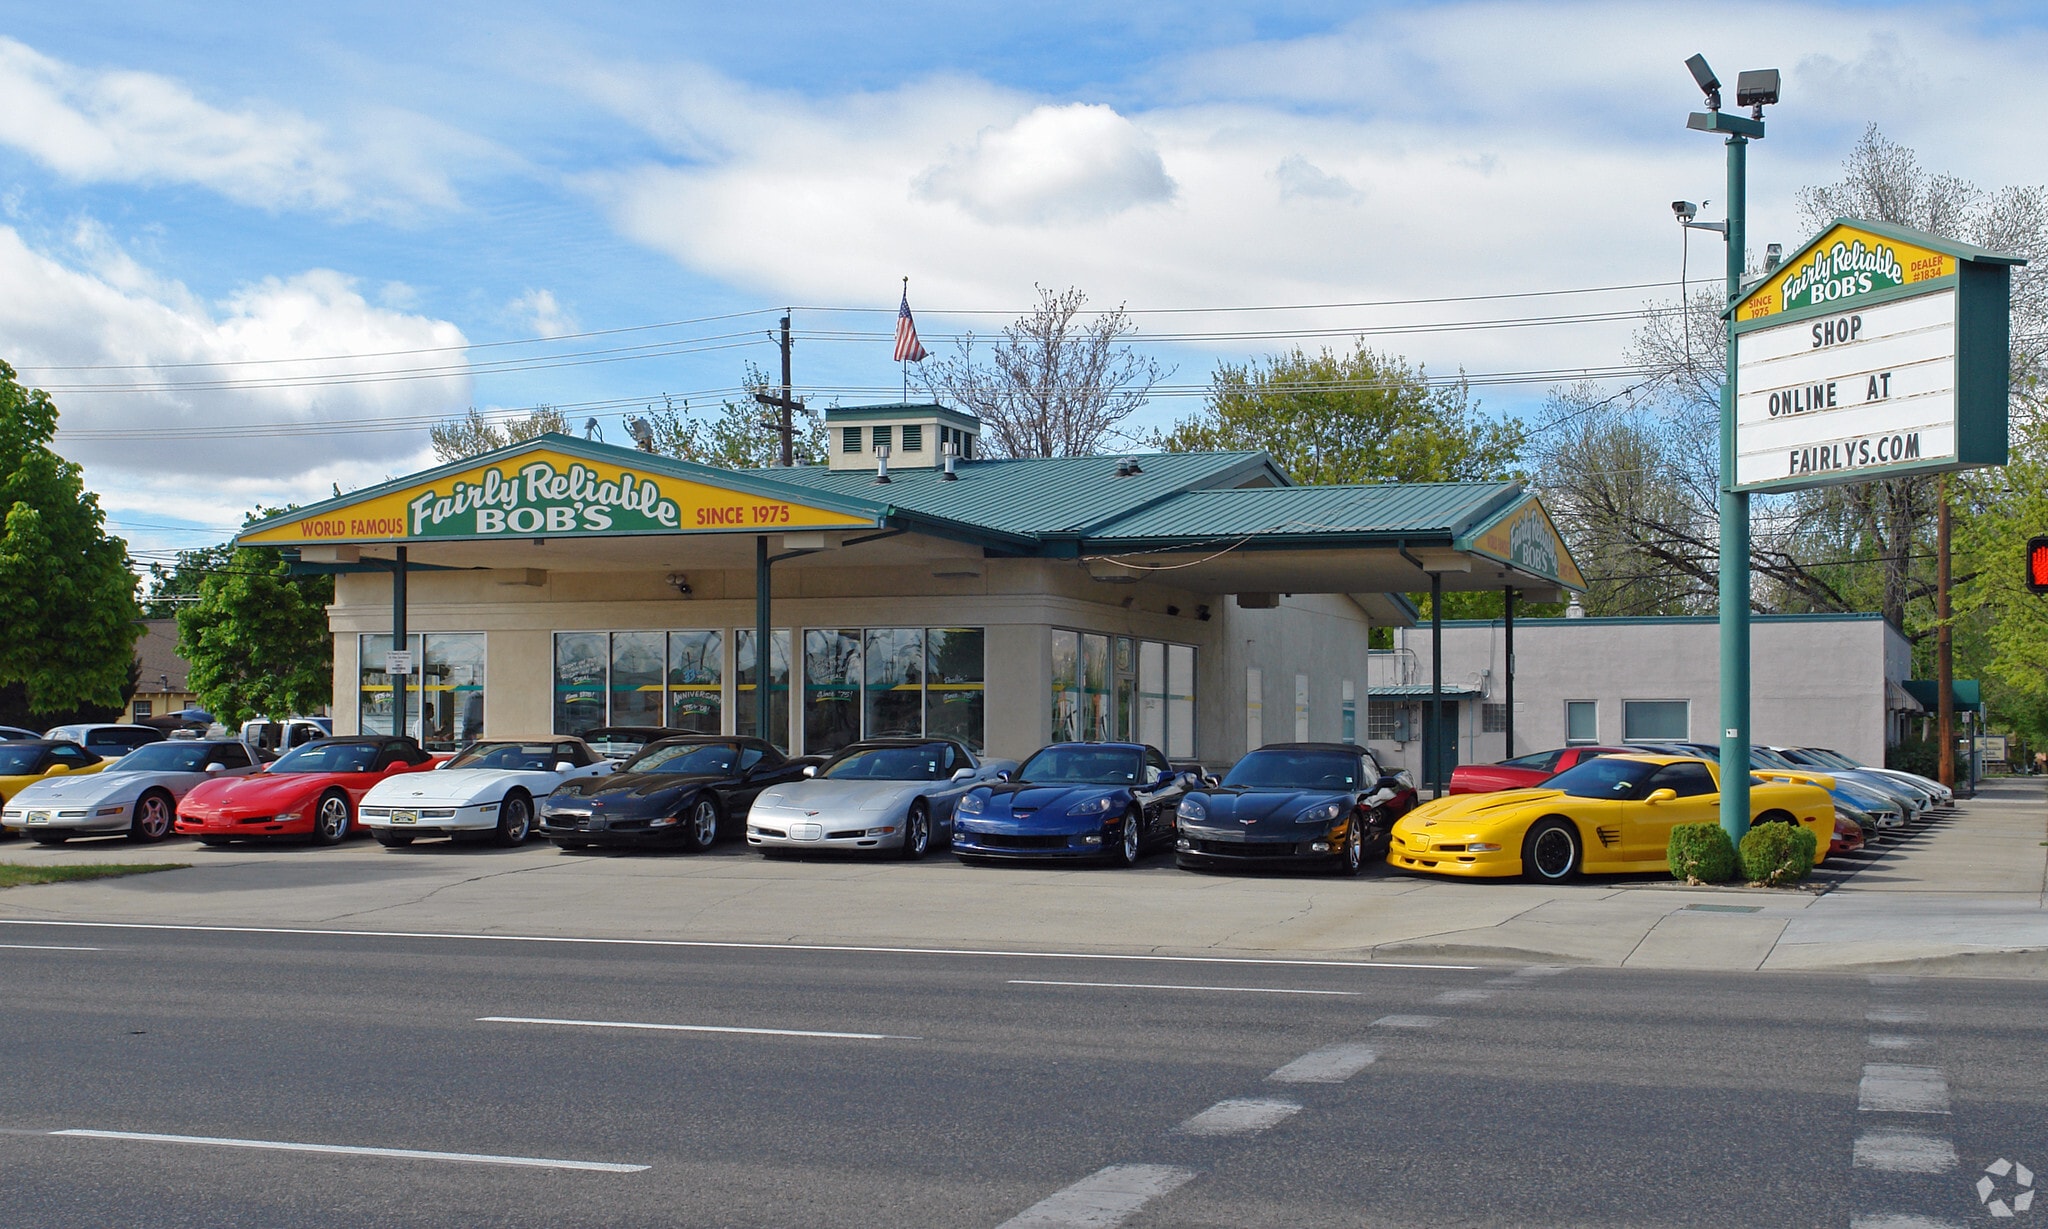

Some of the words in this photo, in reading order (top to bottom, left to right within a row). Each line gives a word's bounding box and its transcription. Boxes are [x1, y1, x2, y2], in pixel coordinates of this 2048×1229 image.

[1782, 251, 1831, 310] Fairly
[1831, 241, 1903, 285] Reliable
[1910, 255, 1944, 272] DEALER
[1913, 267, 1942, 282] #1834
[1748, 295, 1773, 309] SINCE
[1810, 272, 1873, 304] BOB'S
[1751, 306, 1770, 319] 1975
[1812, 315, 1862, 348] SHOP
[1768, 382, 1837, 417] ONLINE
[1866, 372, 1892, 401] AT
[1789, 432, 1920, 475] FAIRLYS.COM
[411, 469, 519, 535] Fairly
[522, 463, 679, 527] Reliable
[301, 520, 346, 537] WORLD
[351, 518, 403, 535] FAMOUS
[476, 502, 613, 534] BOB'S
[696, 506, 744, 525] SINCE
[752, 505, 790, 523] 1975
[1522, 543, 1548, 572] BOB'S
